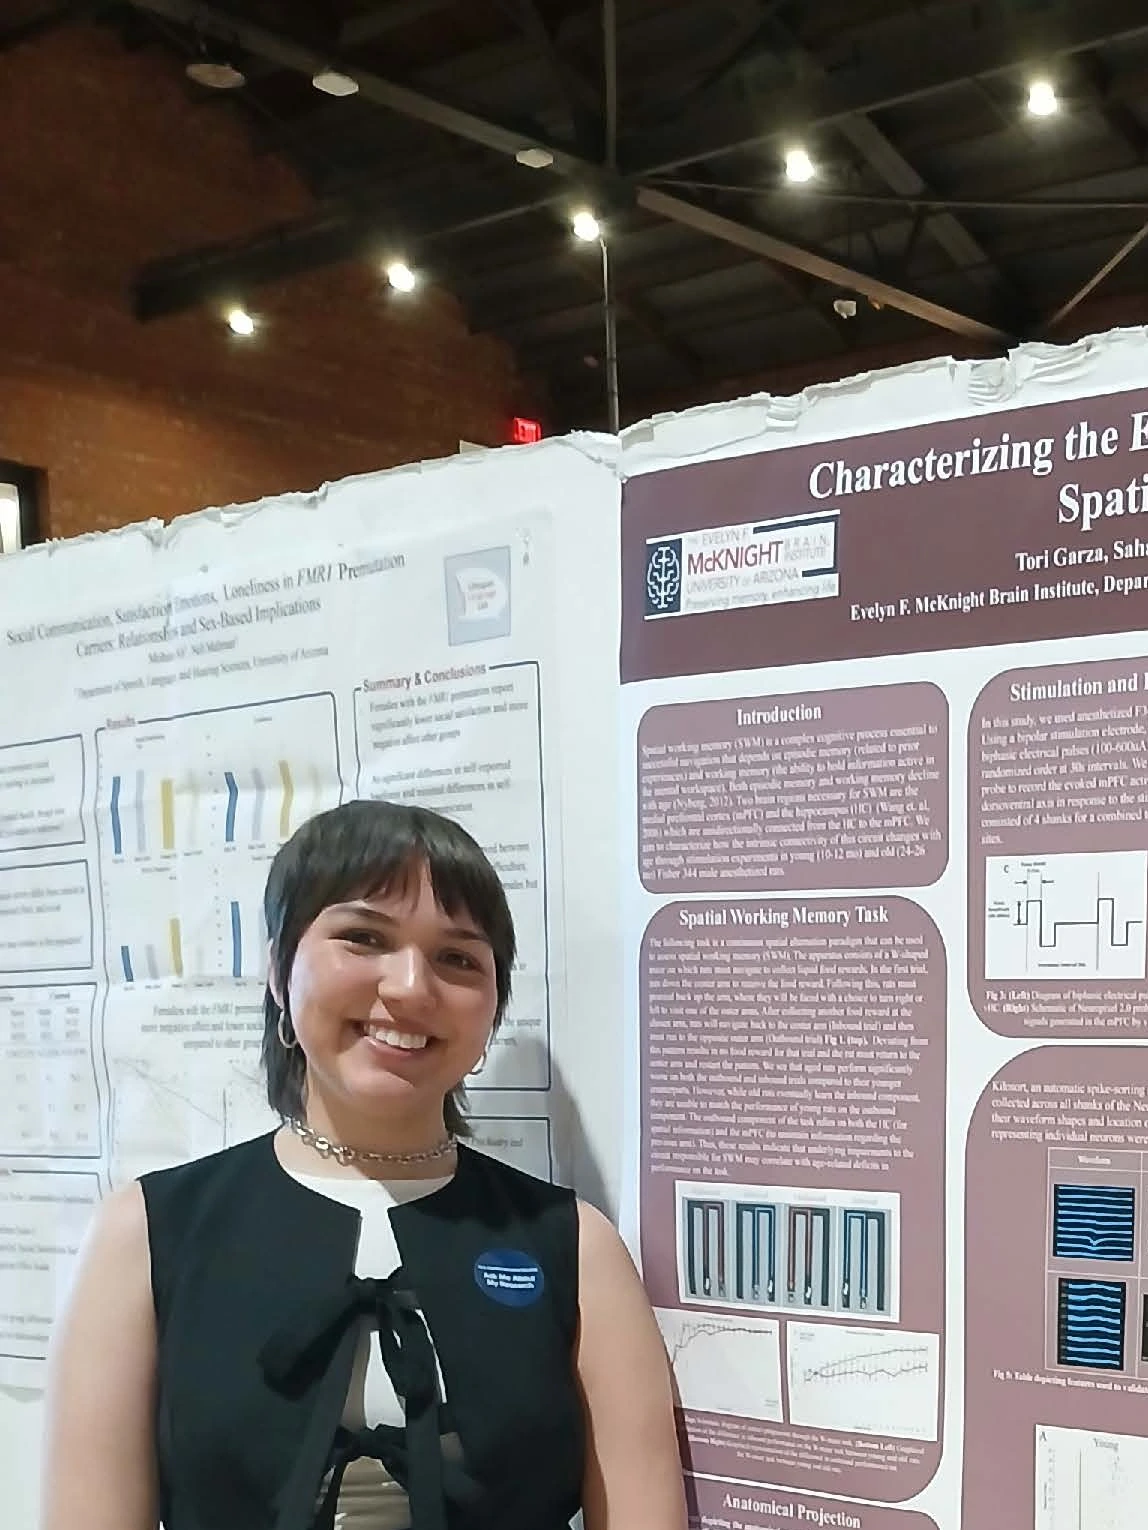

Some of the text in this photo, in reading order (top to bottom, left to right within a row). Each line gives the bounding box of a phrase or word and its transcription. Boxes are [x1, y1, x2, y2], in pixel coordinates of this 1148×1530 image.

[809, 433, 1054, 498] Characterizing
[1064, 421, 1118, 460] the
[688, 541, 783, 575] McKNIGHT
[1014, 549, 1048, 571] Tori
[1053, 547, 1108, 566] Garza,
[850, 602, 895, 622] Evelyn
[900, 598, 910, 615] F.
[915, 591, 984, 613] McKnight
[989, 585, 1028, 605] Brain
[1034, 579, 1099, 600] Institute,
[1010, 677, 1102, 701] Stimulation
[1107, 672, 1138, 693] and
[737, 703, 821, 725] Introduction
[679, 905, 888, 930] Spatial Working Memory Task
[1040, 1431, 1048, 1442] A
[722, 1493, 860, 1529] Anatomical Projection
